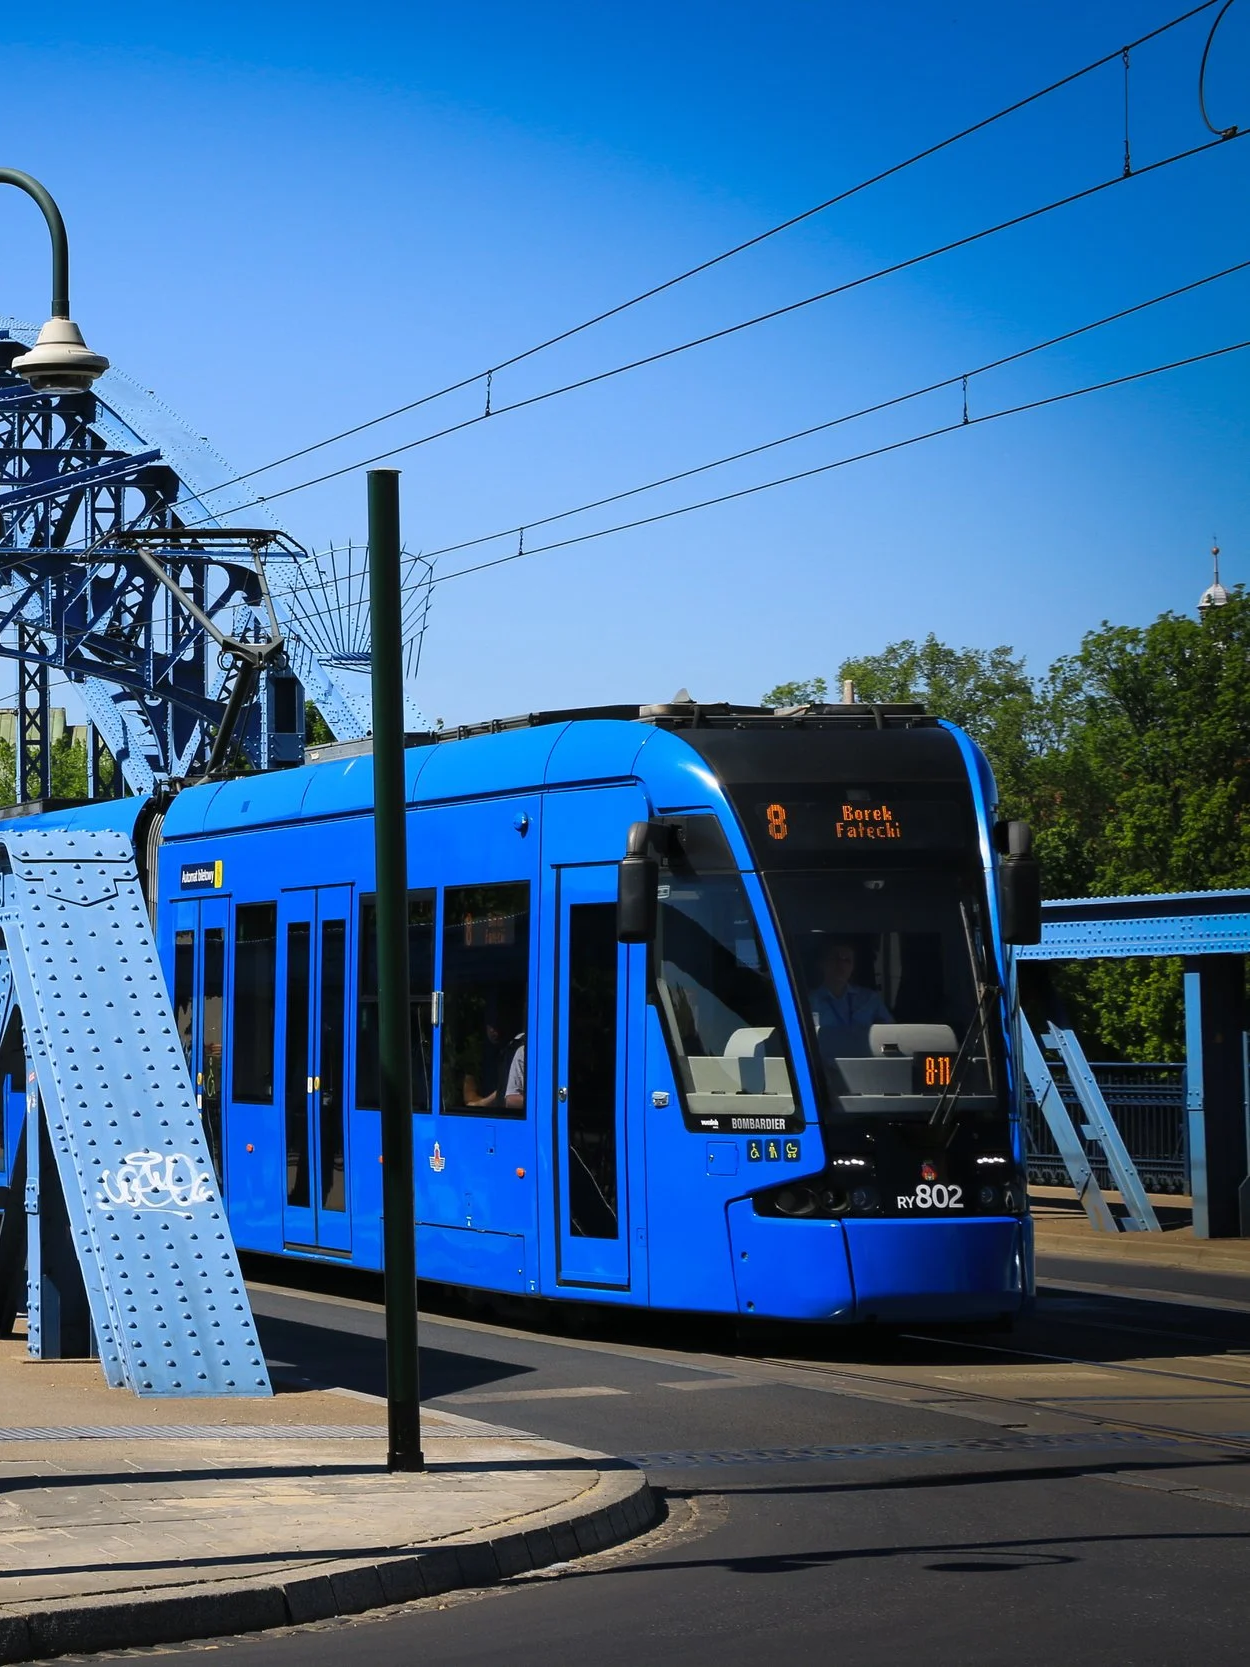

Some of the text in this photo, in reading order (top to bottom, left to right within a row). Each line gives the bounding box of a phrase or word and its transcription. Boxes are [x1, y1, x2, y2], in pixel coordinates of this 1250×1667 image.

[842, 805, 893, 821] Borek
[766, 804, 788, 840] 8
[835, 821, 901, 839] Fałęcki
[731, 1117, 786, 1130] BOMBARDIER
